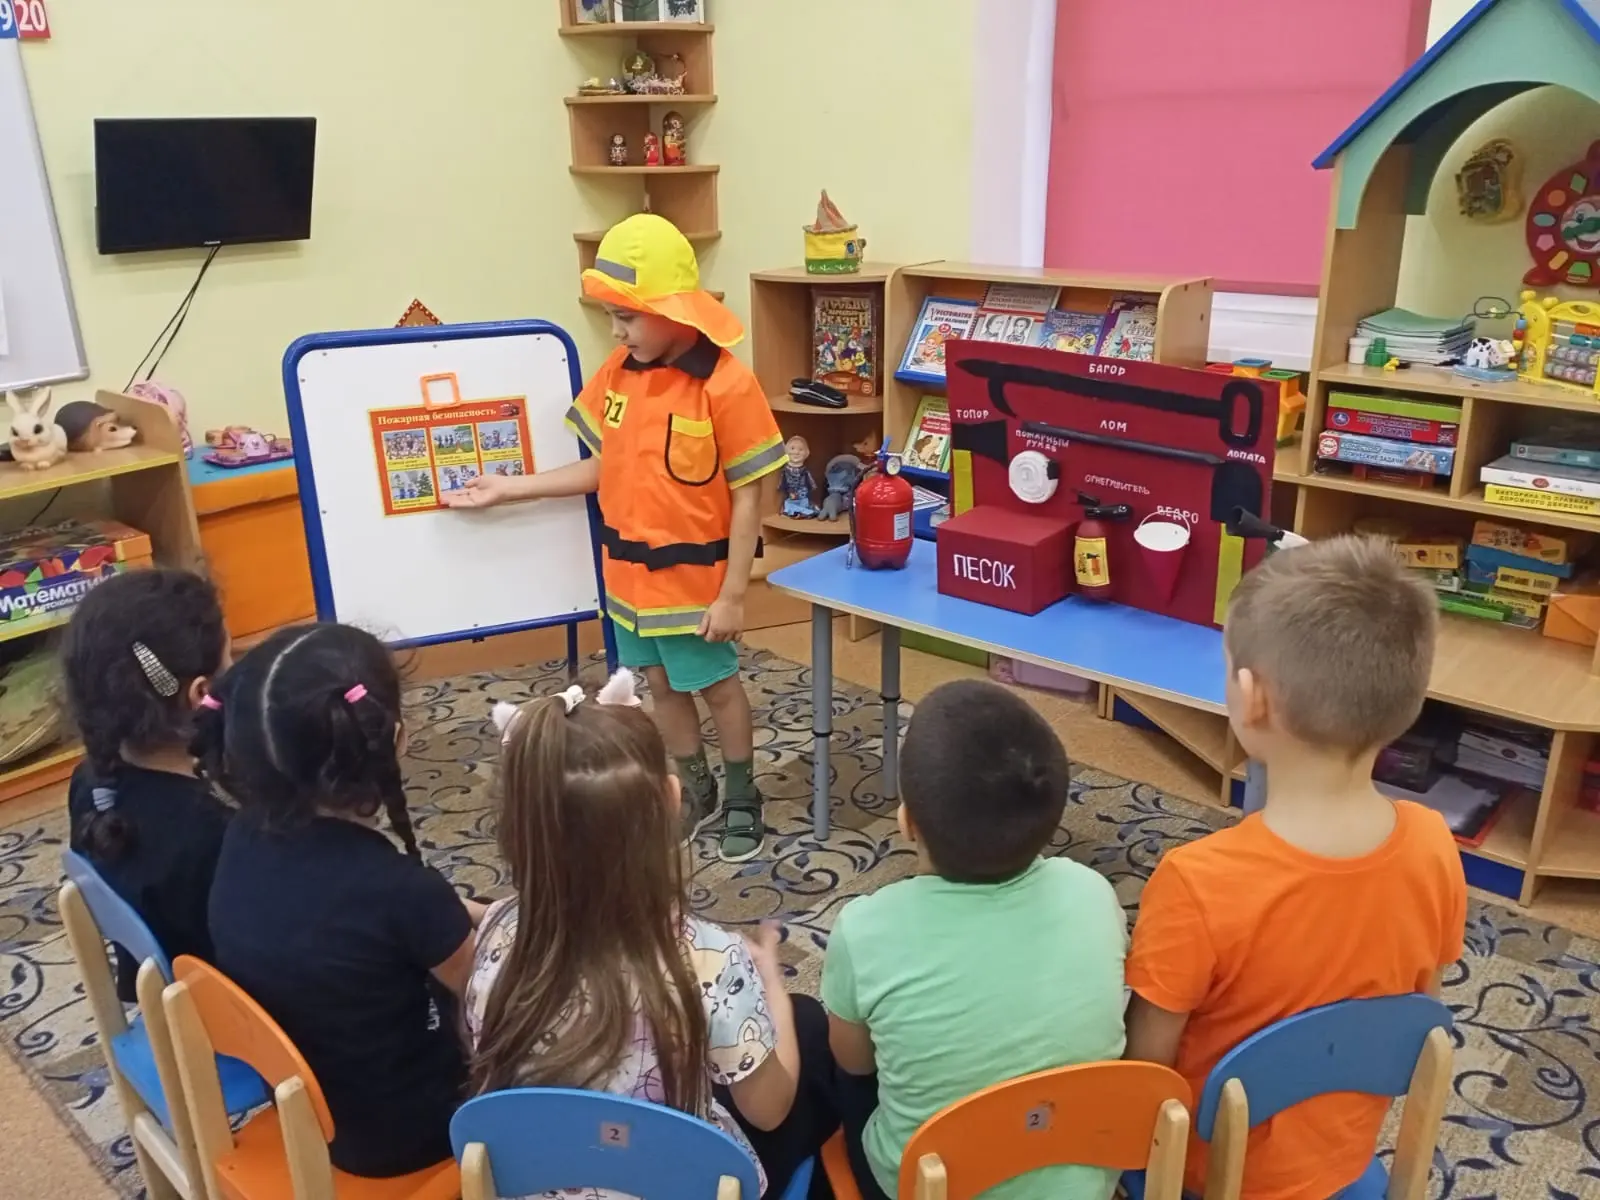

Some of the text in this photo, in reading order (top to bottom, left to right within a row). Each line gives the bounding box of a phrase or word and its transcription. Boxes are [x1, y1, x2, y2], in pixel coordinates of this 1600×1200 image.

[14, 0, 47, 31] 20
[1089, 363, 1126, 376] БАГОР
[378, 407, 497, 425] Пожарная безопасность
[956, 409, 989, 419] ТОПОР
[1100, 419, 1127, 432] ЛОМ
[1227, 449, 1266, 464] ЛОПАТА
[1156, 505, 1199, 524] ВЕДРО
[953, 554, 1017, 589] ПЕСОК
[0, 571, 119, 613] Математи
[1030, 1113, 1040, 1127] 2
[609, 1128, 620, 1141] 2
